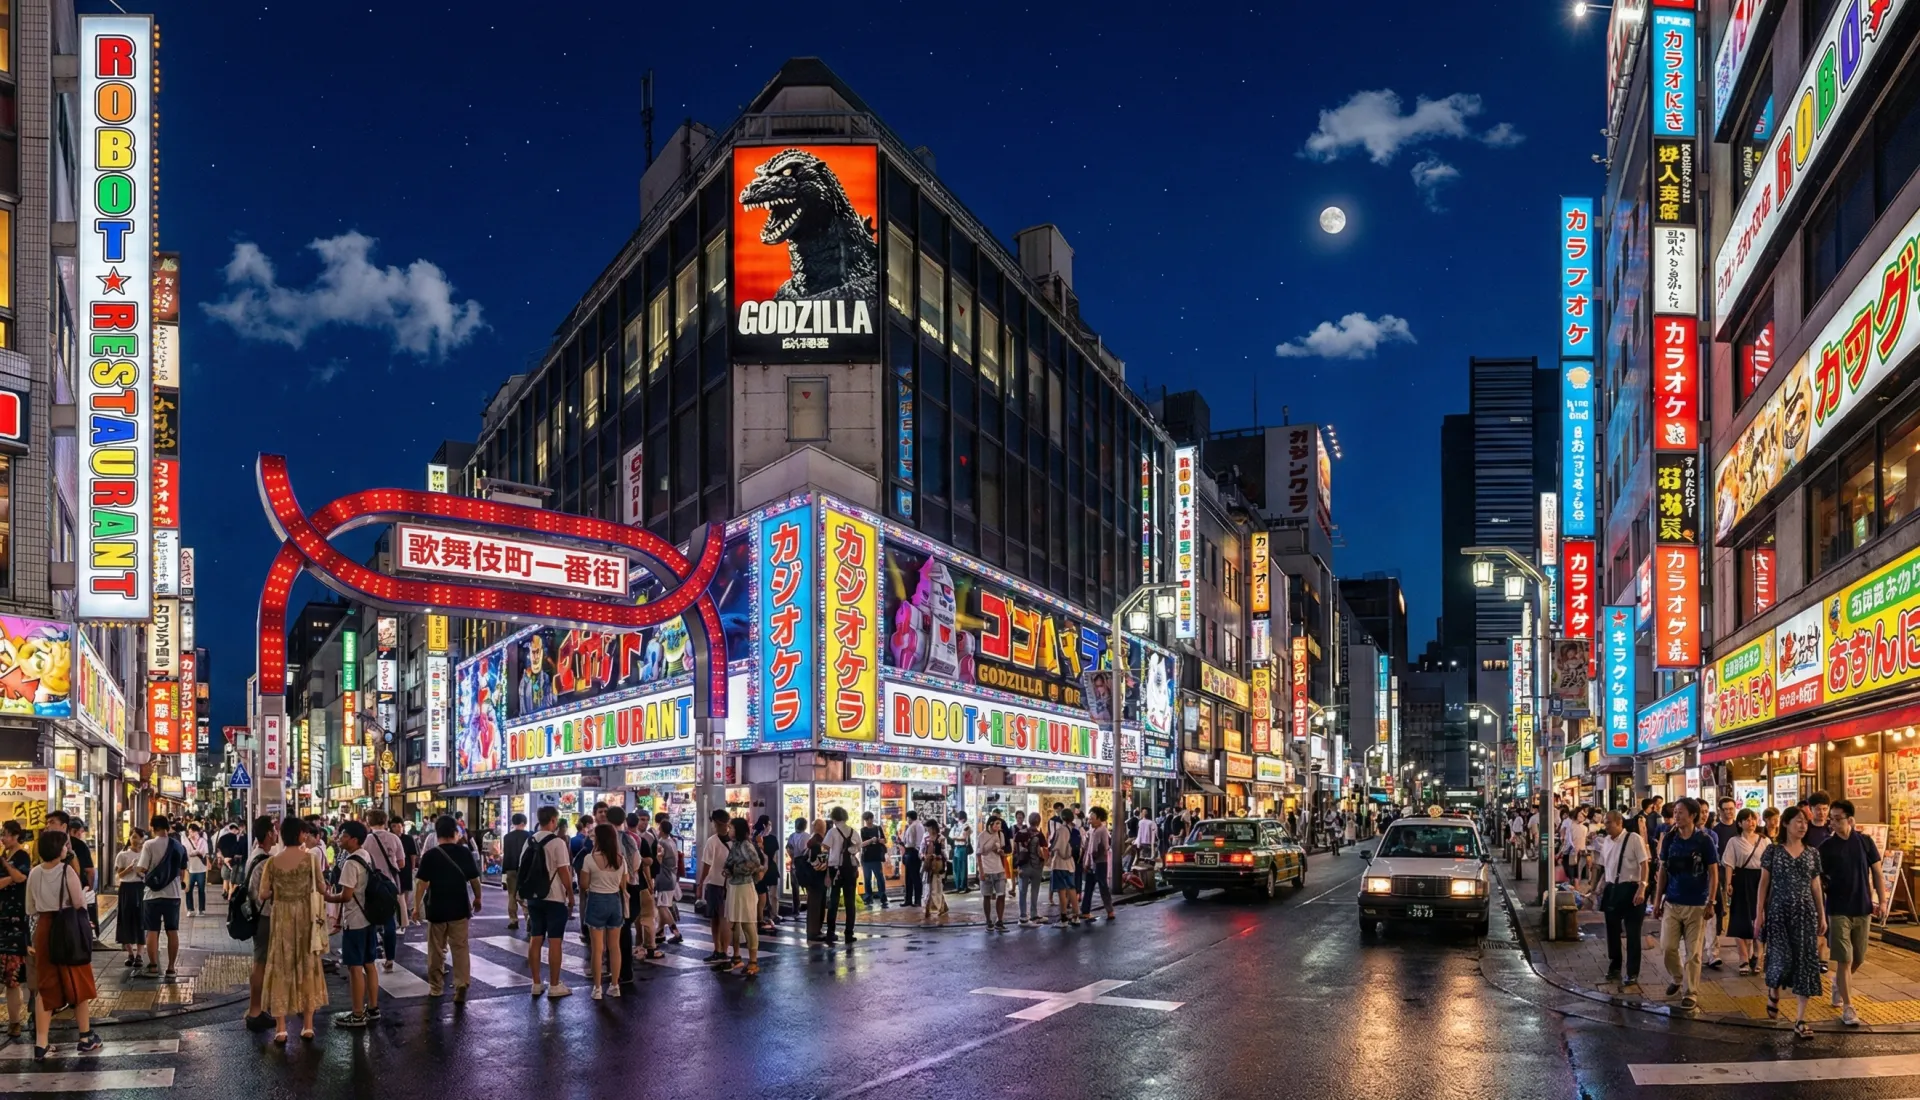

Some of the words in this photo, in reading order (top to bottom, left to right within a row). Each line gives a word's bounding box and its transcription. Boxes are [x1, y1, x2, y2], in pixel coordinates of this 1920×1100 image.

[94, 34, 136, 263] ROBOT
[738, 300, 873, 335] GODZILLA
[89, 301, 139, 600] RESTAURANT
[408, 533, 620, 589] 歌舞伎町一番街
[770, 522, 802, 732] カジオケラ
[835, 524, 867, 732] カジオケラ
[978, 663, 1044, 697] GODZILLA
[509, 725, 554, 762] ROBOT
[562, 695, 692, 755] RESTAURANT
[893, 691, 978, 744] ROBOT
[991, 709, 1099, 759] RESTAURANT
